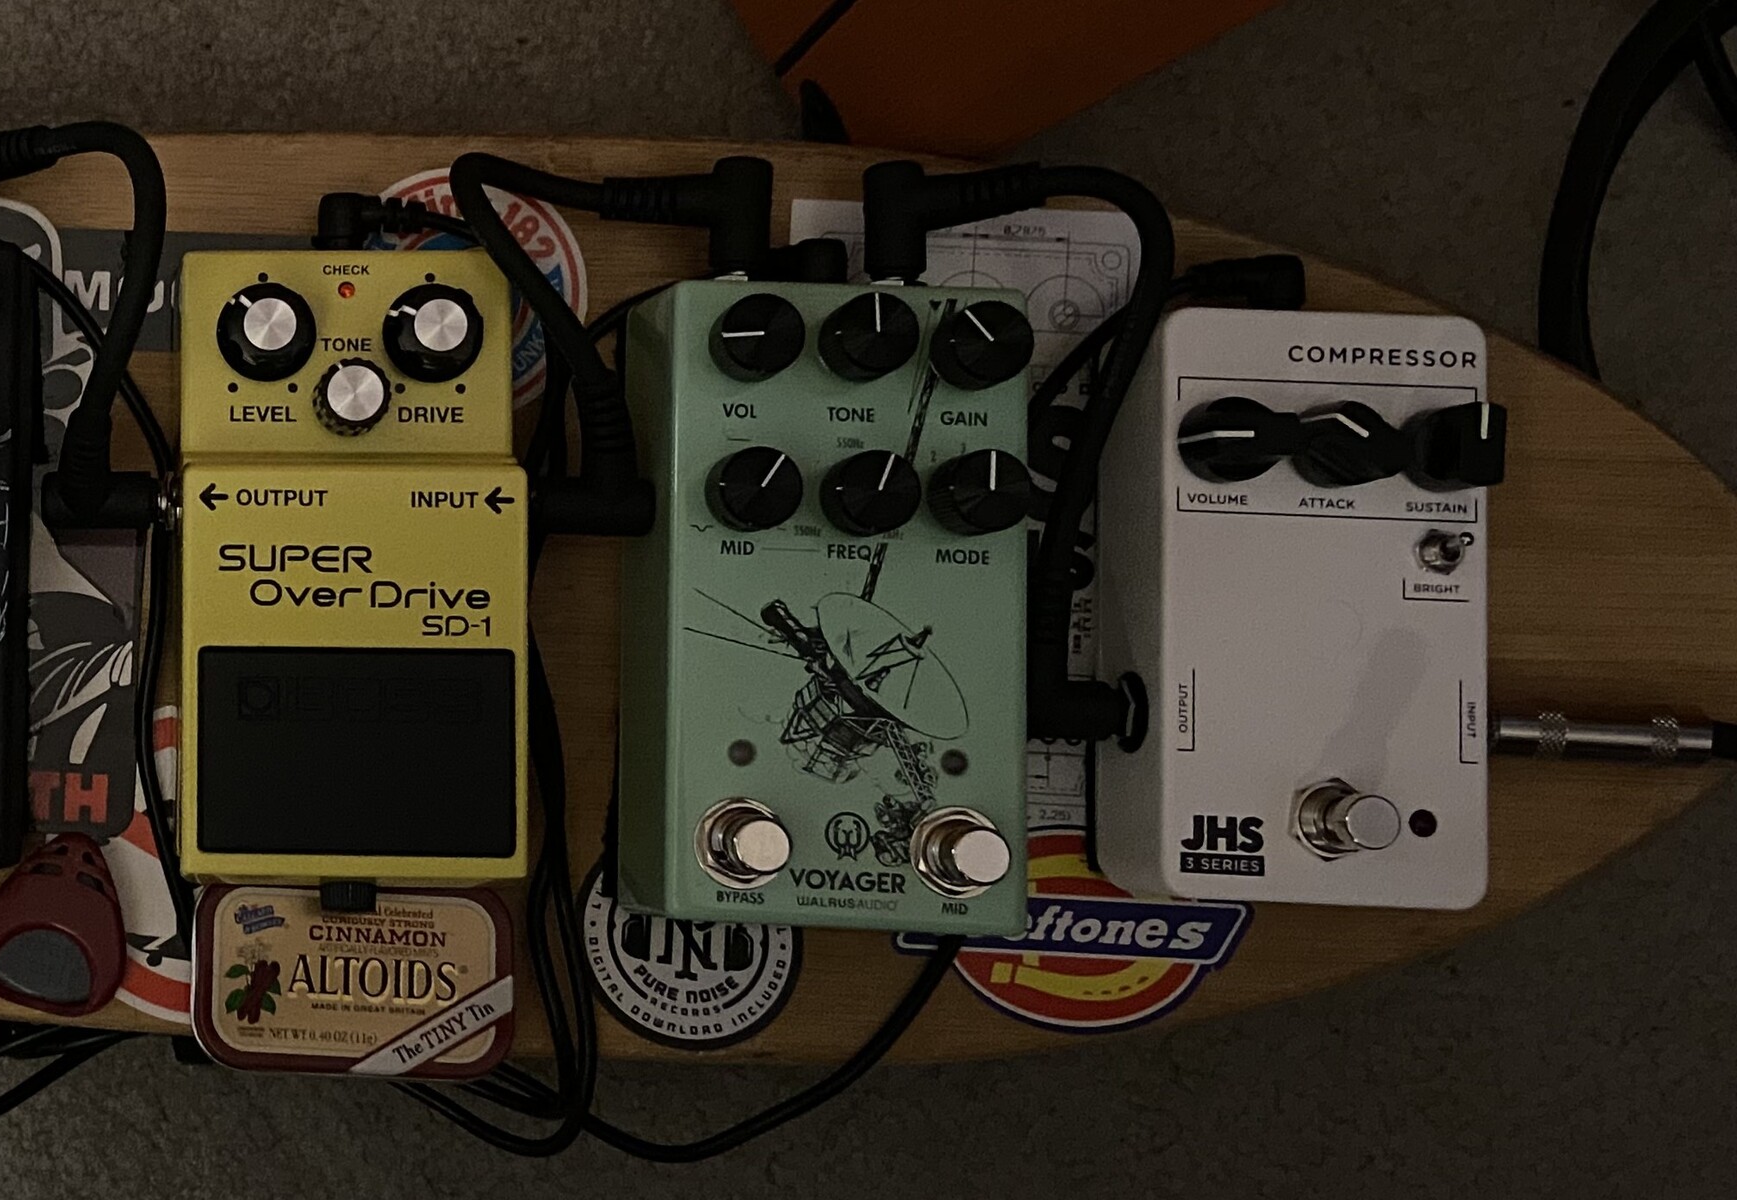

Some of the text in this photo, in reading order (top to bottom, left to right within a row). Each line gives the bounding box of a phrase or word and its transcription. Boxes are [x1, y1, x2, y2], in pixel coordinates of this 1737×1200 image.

[322, 264, 370, 276] CHECK
[321, 338, 372, 353] TONE
[1288, 345, 1478, 368] COMPRESSOR
[229, 406, 297, 423] LEVEL
[397, 406, 464, 424] DRIVE
[722, 403, 757, 419] VOL
[827, 406, 875, 423] TONE
[940, 411, 988, 427] GAIN
[236, 488, 328, 507] OUTPUT
[410, 490, 479, 509] INPUT
[1187, 493, 1249, 506] VOLUME
[1298, 497, 1356, 510] ATTACK
[1405, 501, 1468, 514] SUSTAIN
[720, 540, 755, 557] MID
[827, 543, 872, 561] FREQ
[935, 548, 990, 566] MODE
[218, 544, 373, 573] SUPER
[1413, 583, 1461, 595] BRIGHT
[422, 615, 492, 637] SD-1
[1178, 683, 1188, 733] OUTPUT
[1466, 701, 1476, 739] INPUT
[1180, 814, 1264, 853] JHS
[1185, 857, 1260, 873] 3 SERIES
[788, 868, 906, 895] VOYAGER
[716, 891, 765, 906] BYPASS
[941, 902, 969, 916] MID
[389, 918, 435, 929] STRONG
[1003, 905, 1213, 951] ftones
[308, 925, 447, 947] CINNAMON
[287, 953, 459, 1004] ALTOIDS
[589, 937, 625, 1003] DIGITAL
[630, 1004, 723, 1036] DOWNLOAD
[731, 959, 787, 1027] INCLUDED
[633, 963, 740, 1004] PURE NOISE
[311, 1003, 338, 1011] MADE
[341, 1004, 351, 1012] IN
[353, 1005, 386, 1014] GREAT
[650, 997, 721, 1017] RECORDS
[269, 1027, 289, 1038] NET
[291, 1028, 307, 1039] WT
[334, 1031, 349, 1042] OZ
[392, 1001, 495, 1064] The TINY Tin
